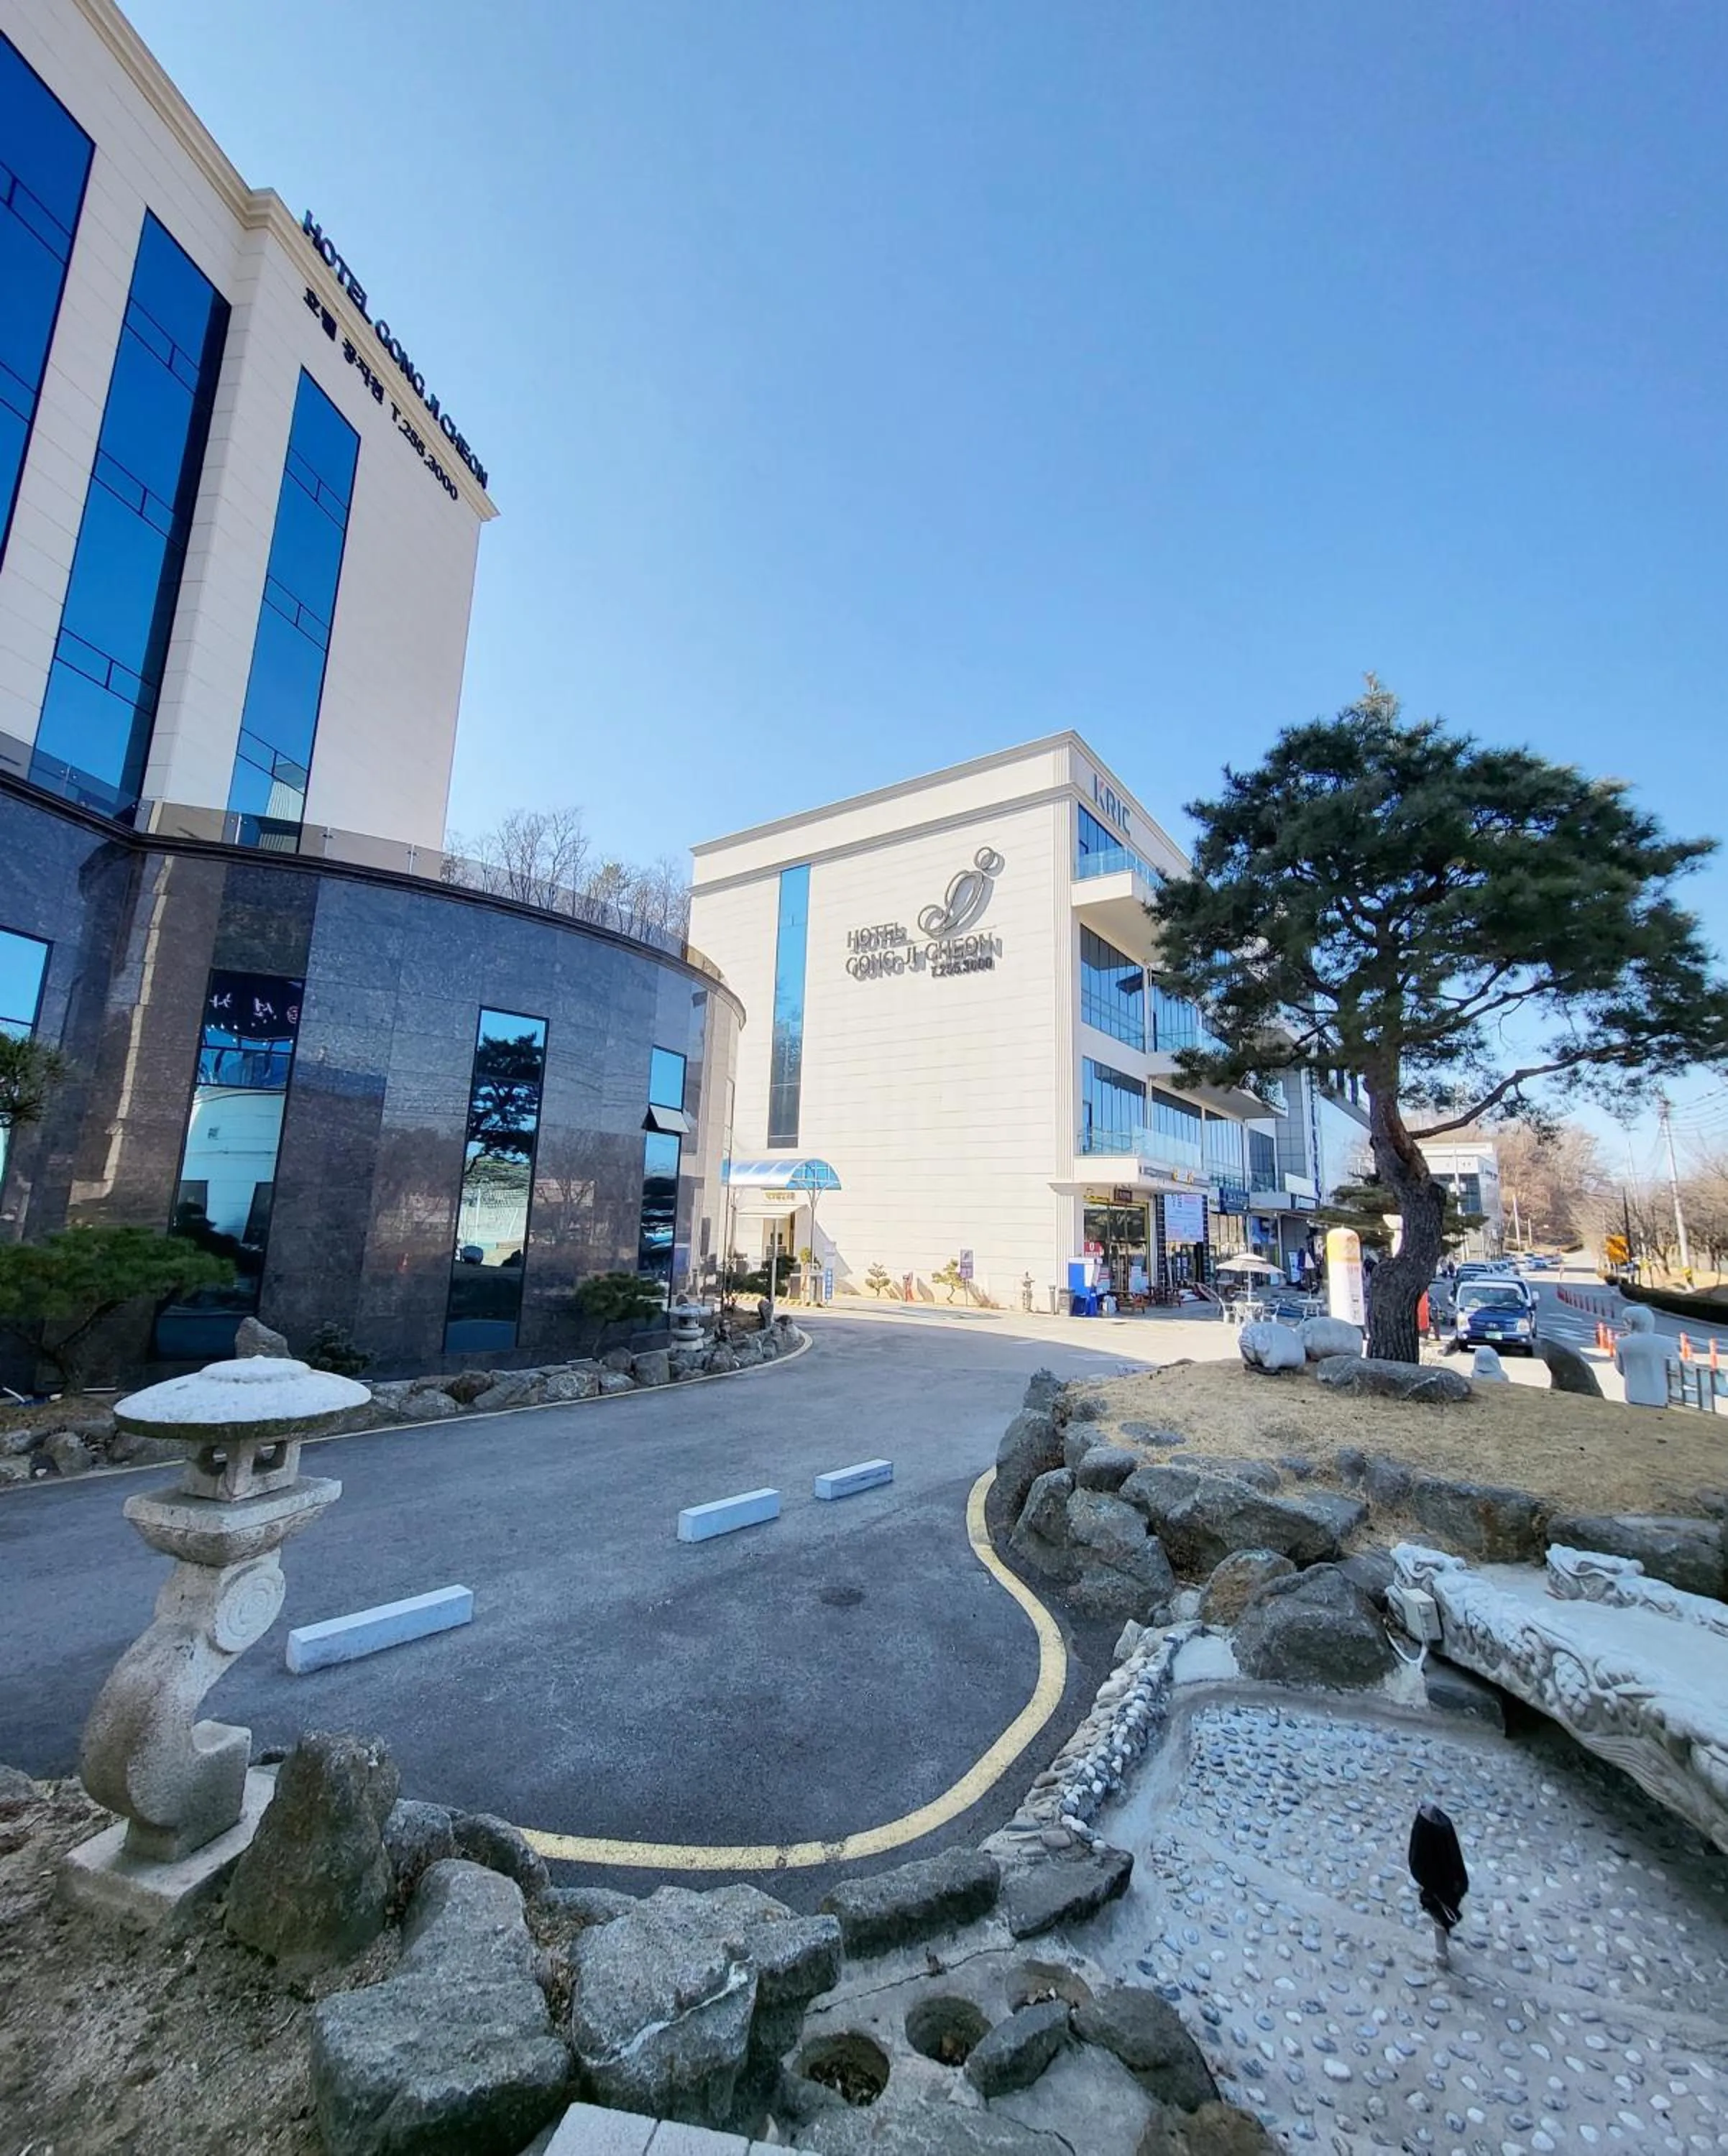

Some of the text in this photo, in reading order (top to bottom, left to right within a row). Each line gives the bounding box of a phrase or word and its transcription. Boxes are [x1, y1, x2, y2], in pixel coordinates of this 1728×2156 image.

[303, 209, 372, 325] HOTEL
[1093, 773, 1131, 839] KRIC
[847, 922, 905, 950] HOTEL
